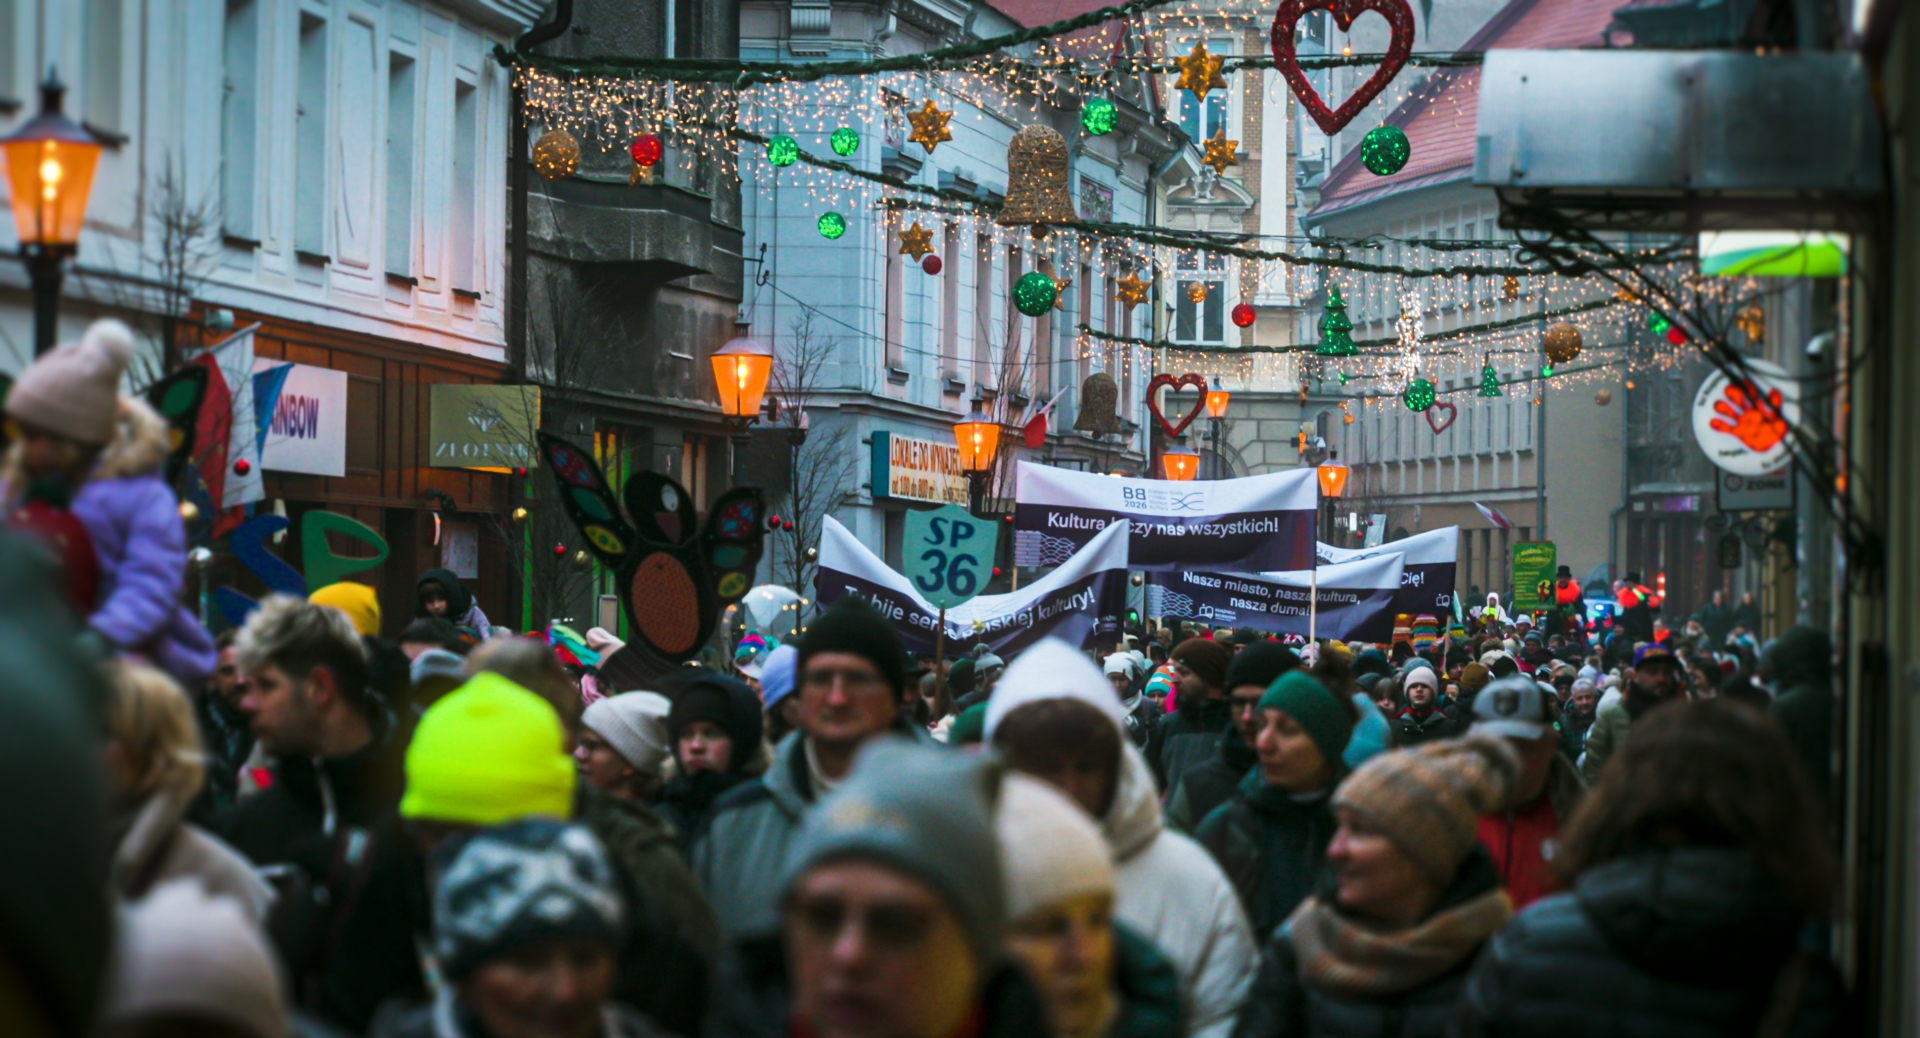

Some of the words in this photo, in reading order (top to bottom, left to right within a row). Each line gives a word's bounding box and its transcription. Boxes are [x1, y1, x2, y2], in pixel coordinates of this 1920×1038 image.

[270, 393, 319, 440] INBOW
[891, 436, 917, 470] LOKALE
[919, 442, 928, 472] DO
[930, 444, 963, 476] WYNAJĘC
[892, 476, 898, 495] od
[911, 478, 917, 497] do
[1125, 500, 1147, 509] 2026
[923, 516, 975, 548] SP
[1047, 512, 1106, 530] Kultura
[1111, 517, 1153, 538] czy
[1157, 524, 1186, 536] nas
[1189, 517, 1279, 539] wszystkich!
[915, 549, 979, 597] 36
[1183, 571, 1222, 588] Nasze
[1224, 581, 1271, 599] miasto,
[1275, 588, 1312, 602] nasza
[1316, 590, 1361, 606] kultura,
[1400, 571, 1424, 588] Cię!
[871, 593, 904, 620] bije
[1037, 586, 1096, 620] kultury!
[1230, 597, 1267, 612] nasza
[1270, 602, 1310, 617] duma!
